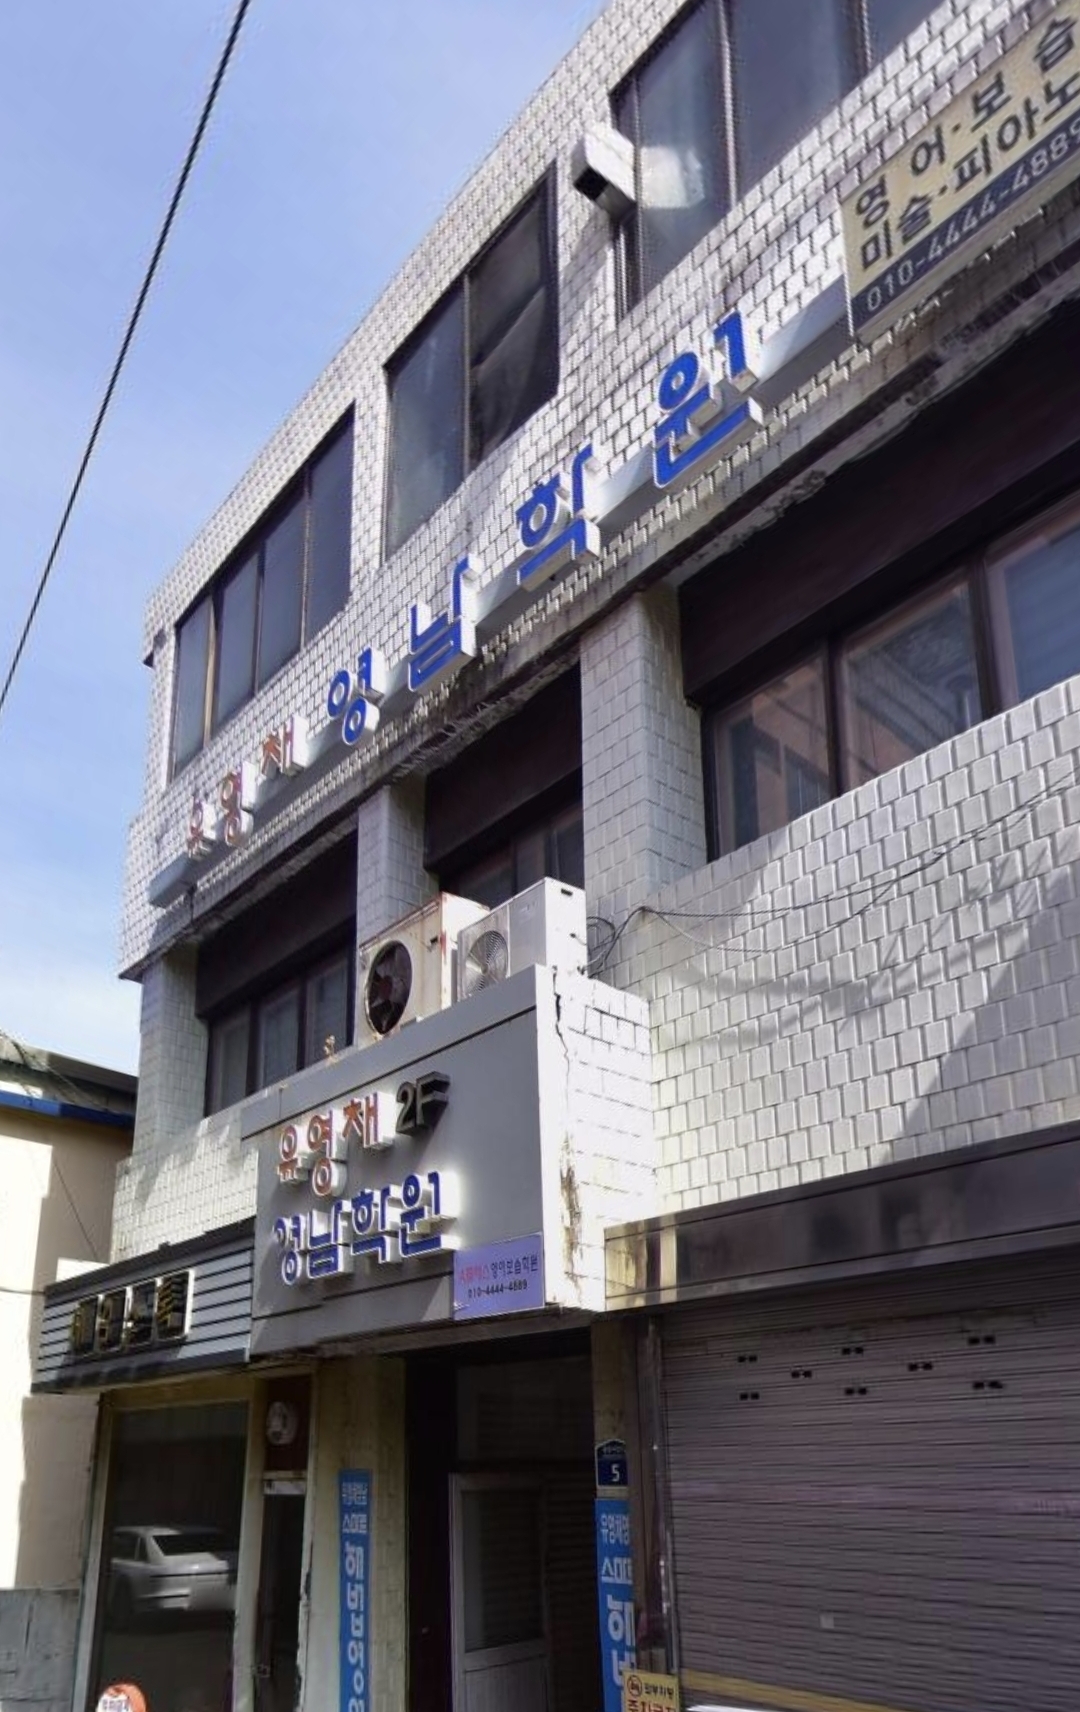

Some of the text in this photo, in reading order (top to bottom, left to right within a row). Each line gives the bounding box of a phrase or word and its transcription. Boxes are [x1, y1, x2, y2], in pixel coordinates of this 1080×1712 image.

[278, 1092, 380, 1197] 유영채
[273, 1171, 445, 1286] 영남학원
[611, 1464, 620, 1482] 5
